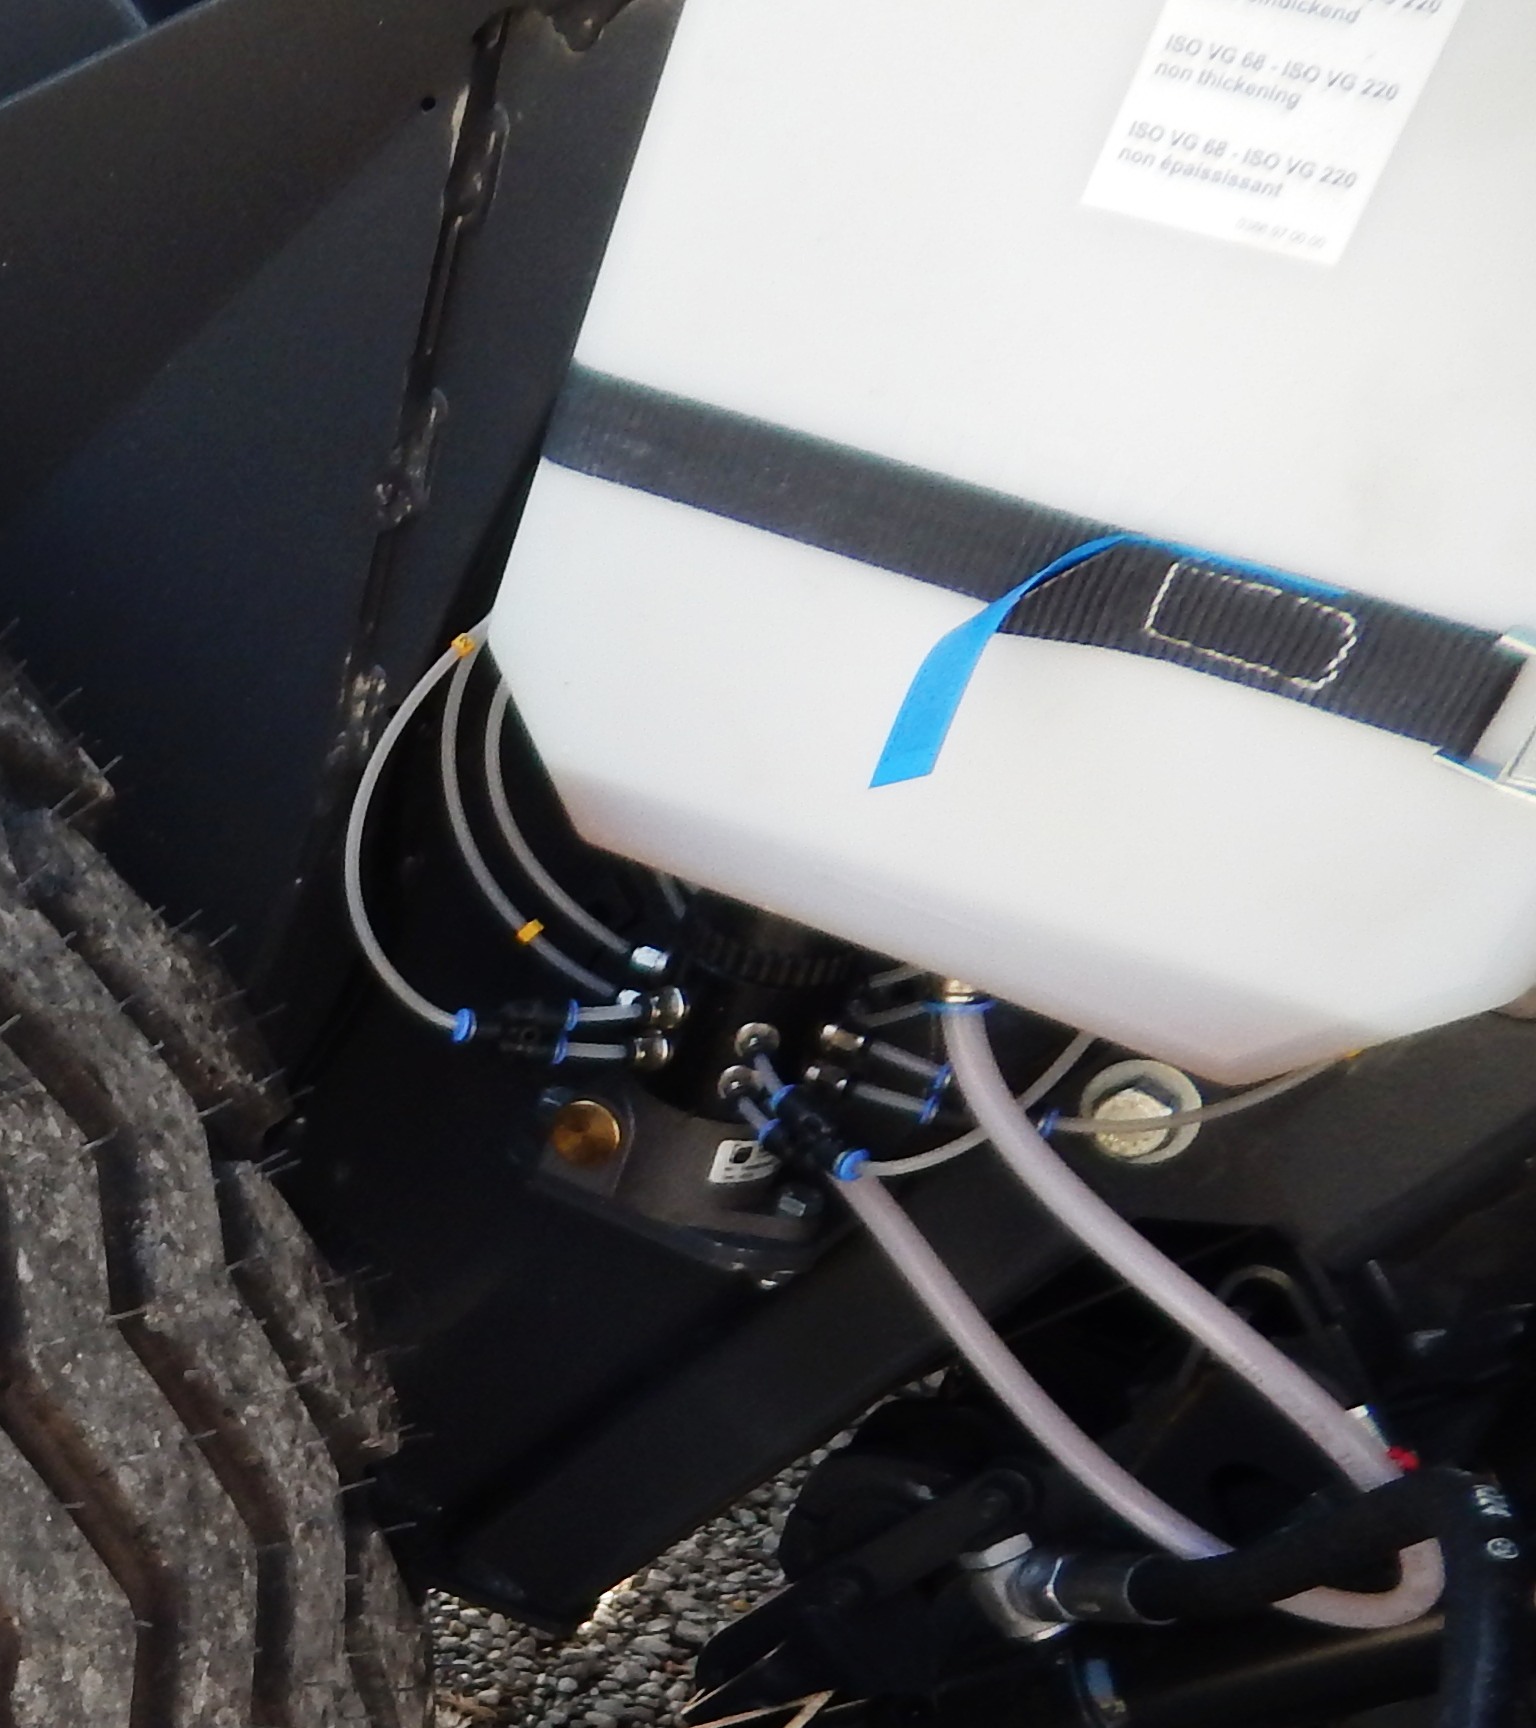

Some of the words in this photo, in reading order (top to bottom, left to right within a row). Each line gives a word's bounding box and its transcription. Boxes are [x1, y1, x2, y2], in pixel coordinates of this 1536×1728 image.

[1154, 62, 1193, 81] non
[1197, 68, 1302, 111] thickening
[1165, 33, 1202, 57] ISO
[1209, 42, 1237, 64] VG
[1241, 51, 1266, 71] 68
[1281, 60, 1321, 83] ISO
[1328, 70, 1358, 92] VG
[1361, 78, 1400, 101] 220
[1118, 147, 1156, 168] non
[1160, 153, 1283, 198] épaississant
[1128, 119, 1165, 143] ISO
[1171, 128, 1199, 151] VG
[1202, 138, 1227, 158] 68
[1242, 148, 1280, 171] ISO
[1287, 156, 1317, 178] VG
[1318, 166, 1358, 189] 220
